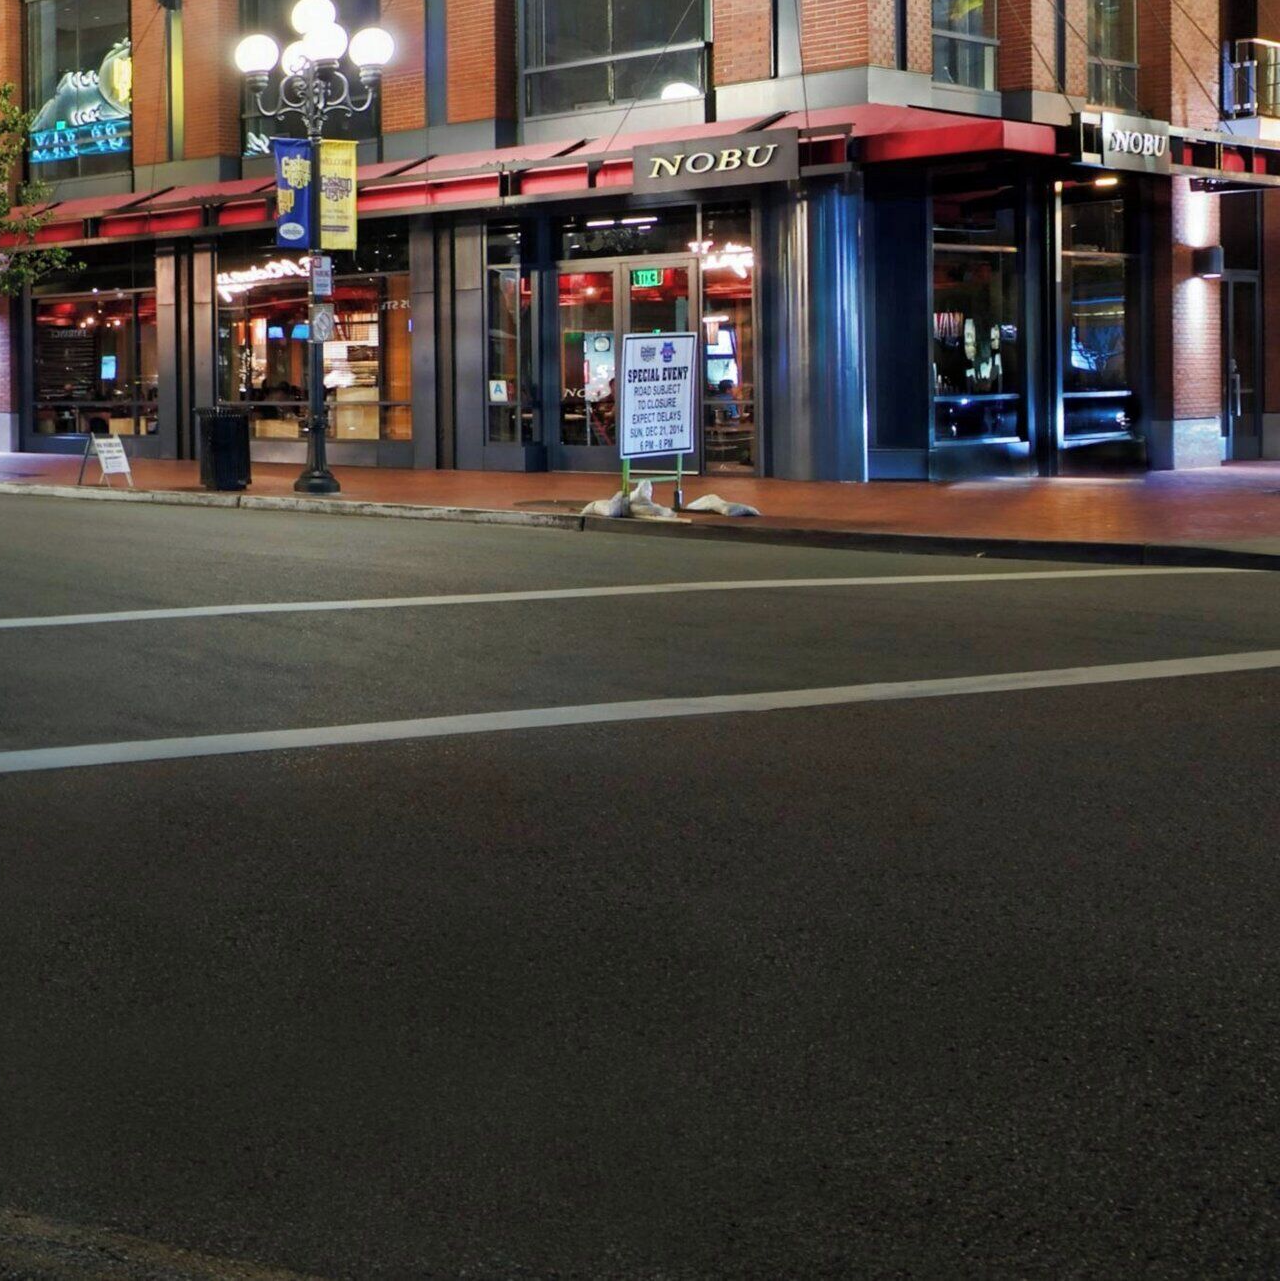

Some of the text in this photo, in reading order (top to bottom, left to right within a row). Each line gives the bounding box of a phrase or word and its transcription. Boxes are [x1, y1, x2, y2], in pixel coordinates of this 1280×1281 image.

[1112, 128, 1167, 157] NOBU
[648, 144, 778, 178] NOBU
[628, 366, 689, 383] SPECIAL EVENT
[494, 383, 503, 394] A
[634, 383, 681, 396] ROAD SUBJECT
[638, 397, 677, 410] TO CLOSURE
[632, 410, 681, 424] EXPECT DELAYS
[669, 424, 683, 435] 2014
[645, 440, 654, 449] PM
[663, 438, 673, 448] PM
